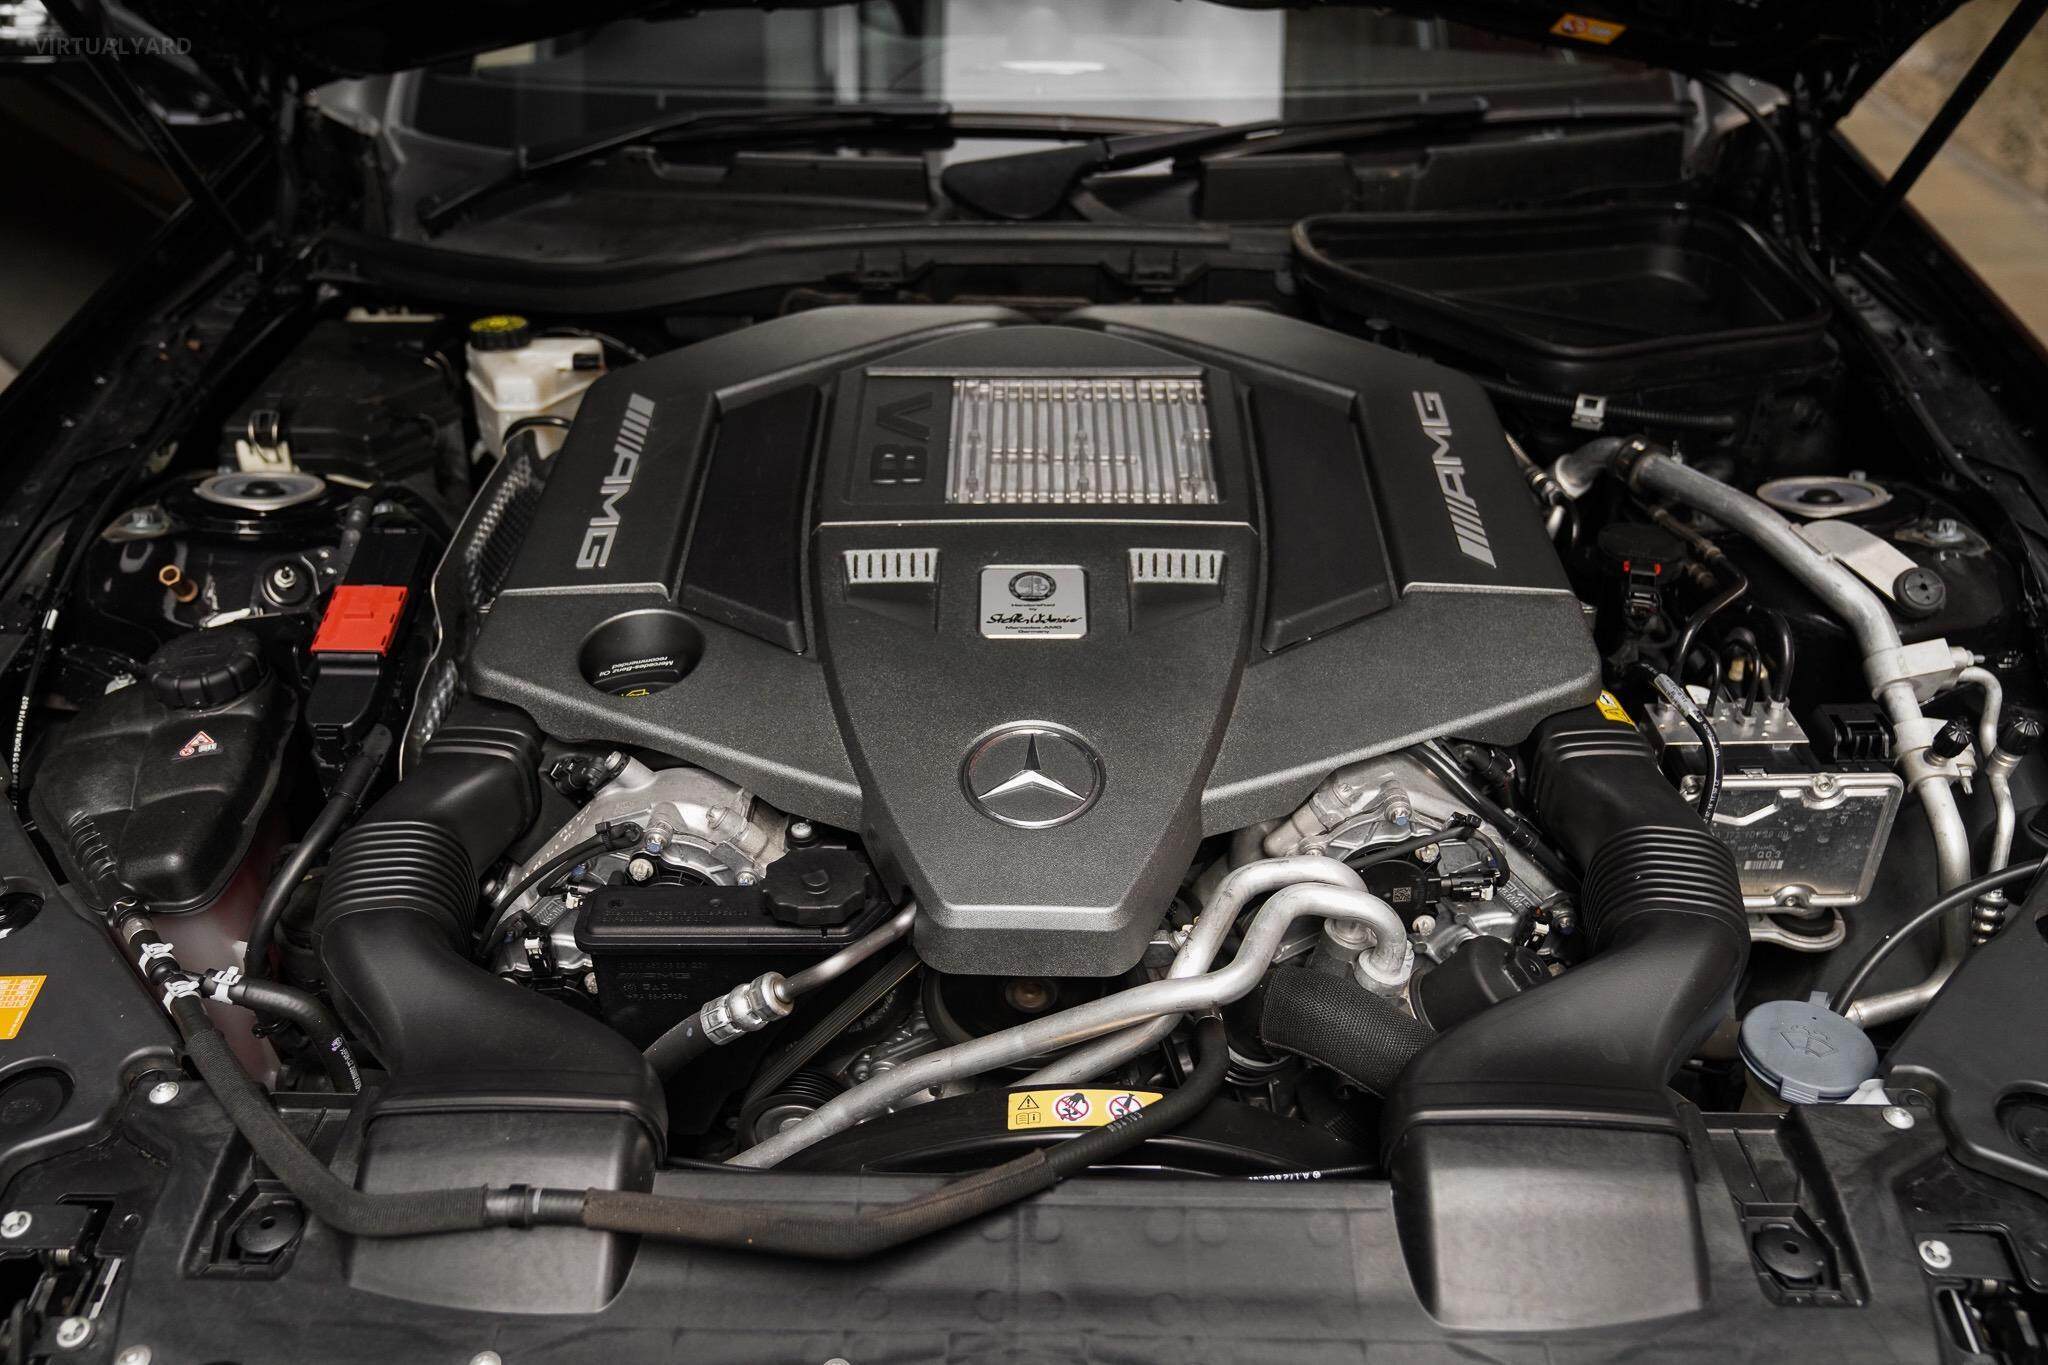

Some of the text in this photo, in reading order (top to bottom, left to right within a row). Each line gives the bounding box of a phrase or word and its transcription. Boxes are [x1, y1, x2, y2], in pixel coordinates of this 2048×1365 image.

[1412, 391, 1477, 508] AMG
[576, 445, 640, 569] AMG
[611, 656, 668, 669] recommended
[612, 660, 674, 674] Mercedes-Benz
